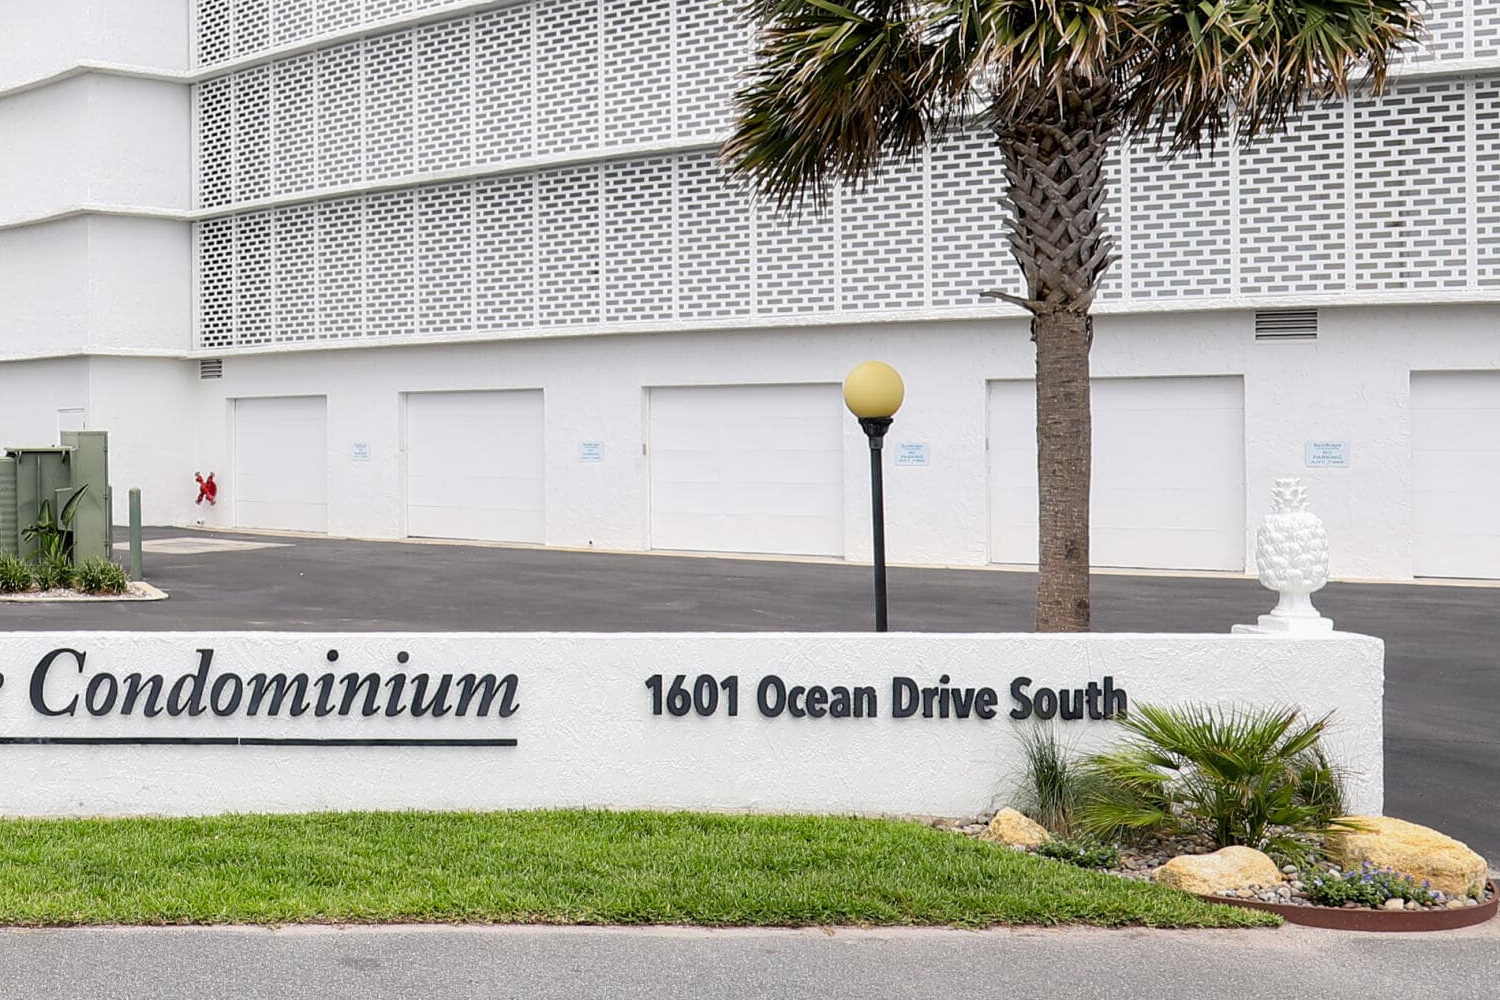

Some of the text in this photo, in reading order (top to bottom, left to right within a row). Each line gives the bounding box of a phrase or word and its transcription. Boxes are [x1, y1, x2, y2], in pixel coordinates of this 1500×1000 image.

[29, 647, 521, 719] Condominium
[644, 673, 1128, 723] 1601 Ocean Drive South
